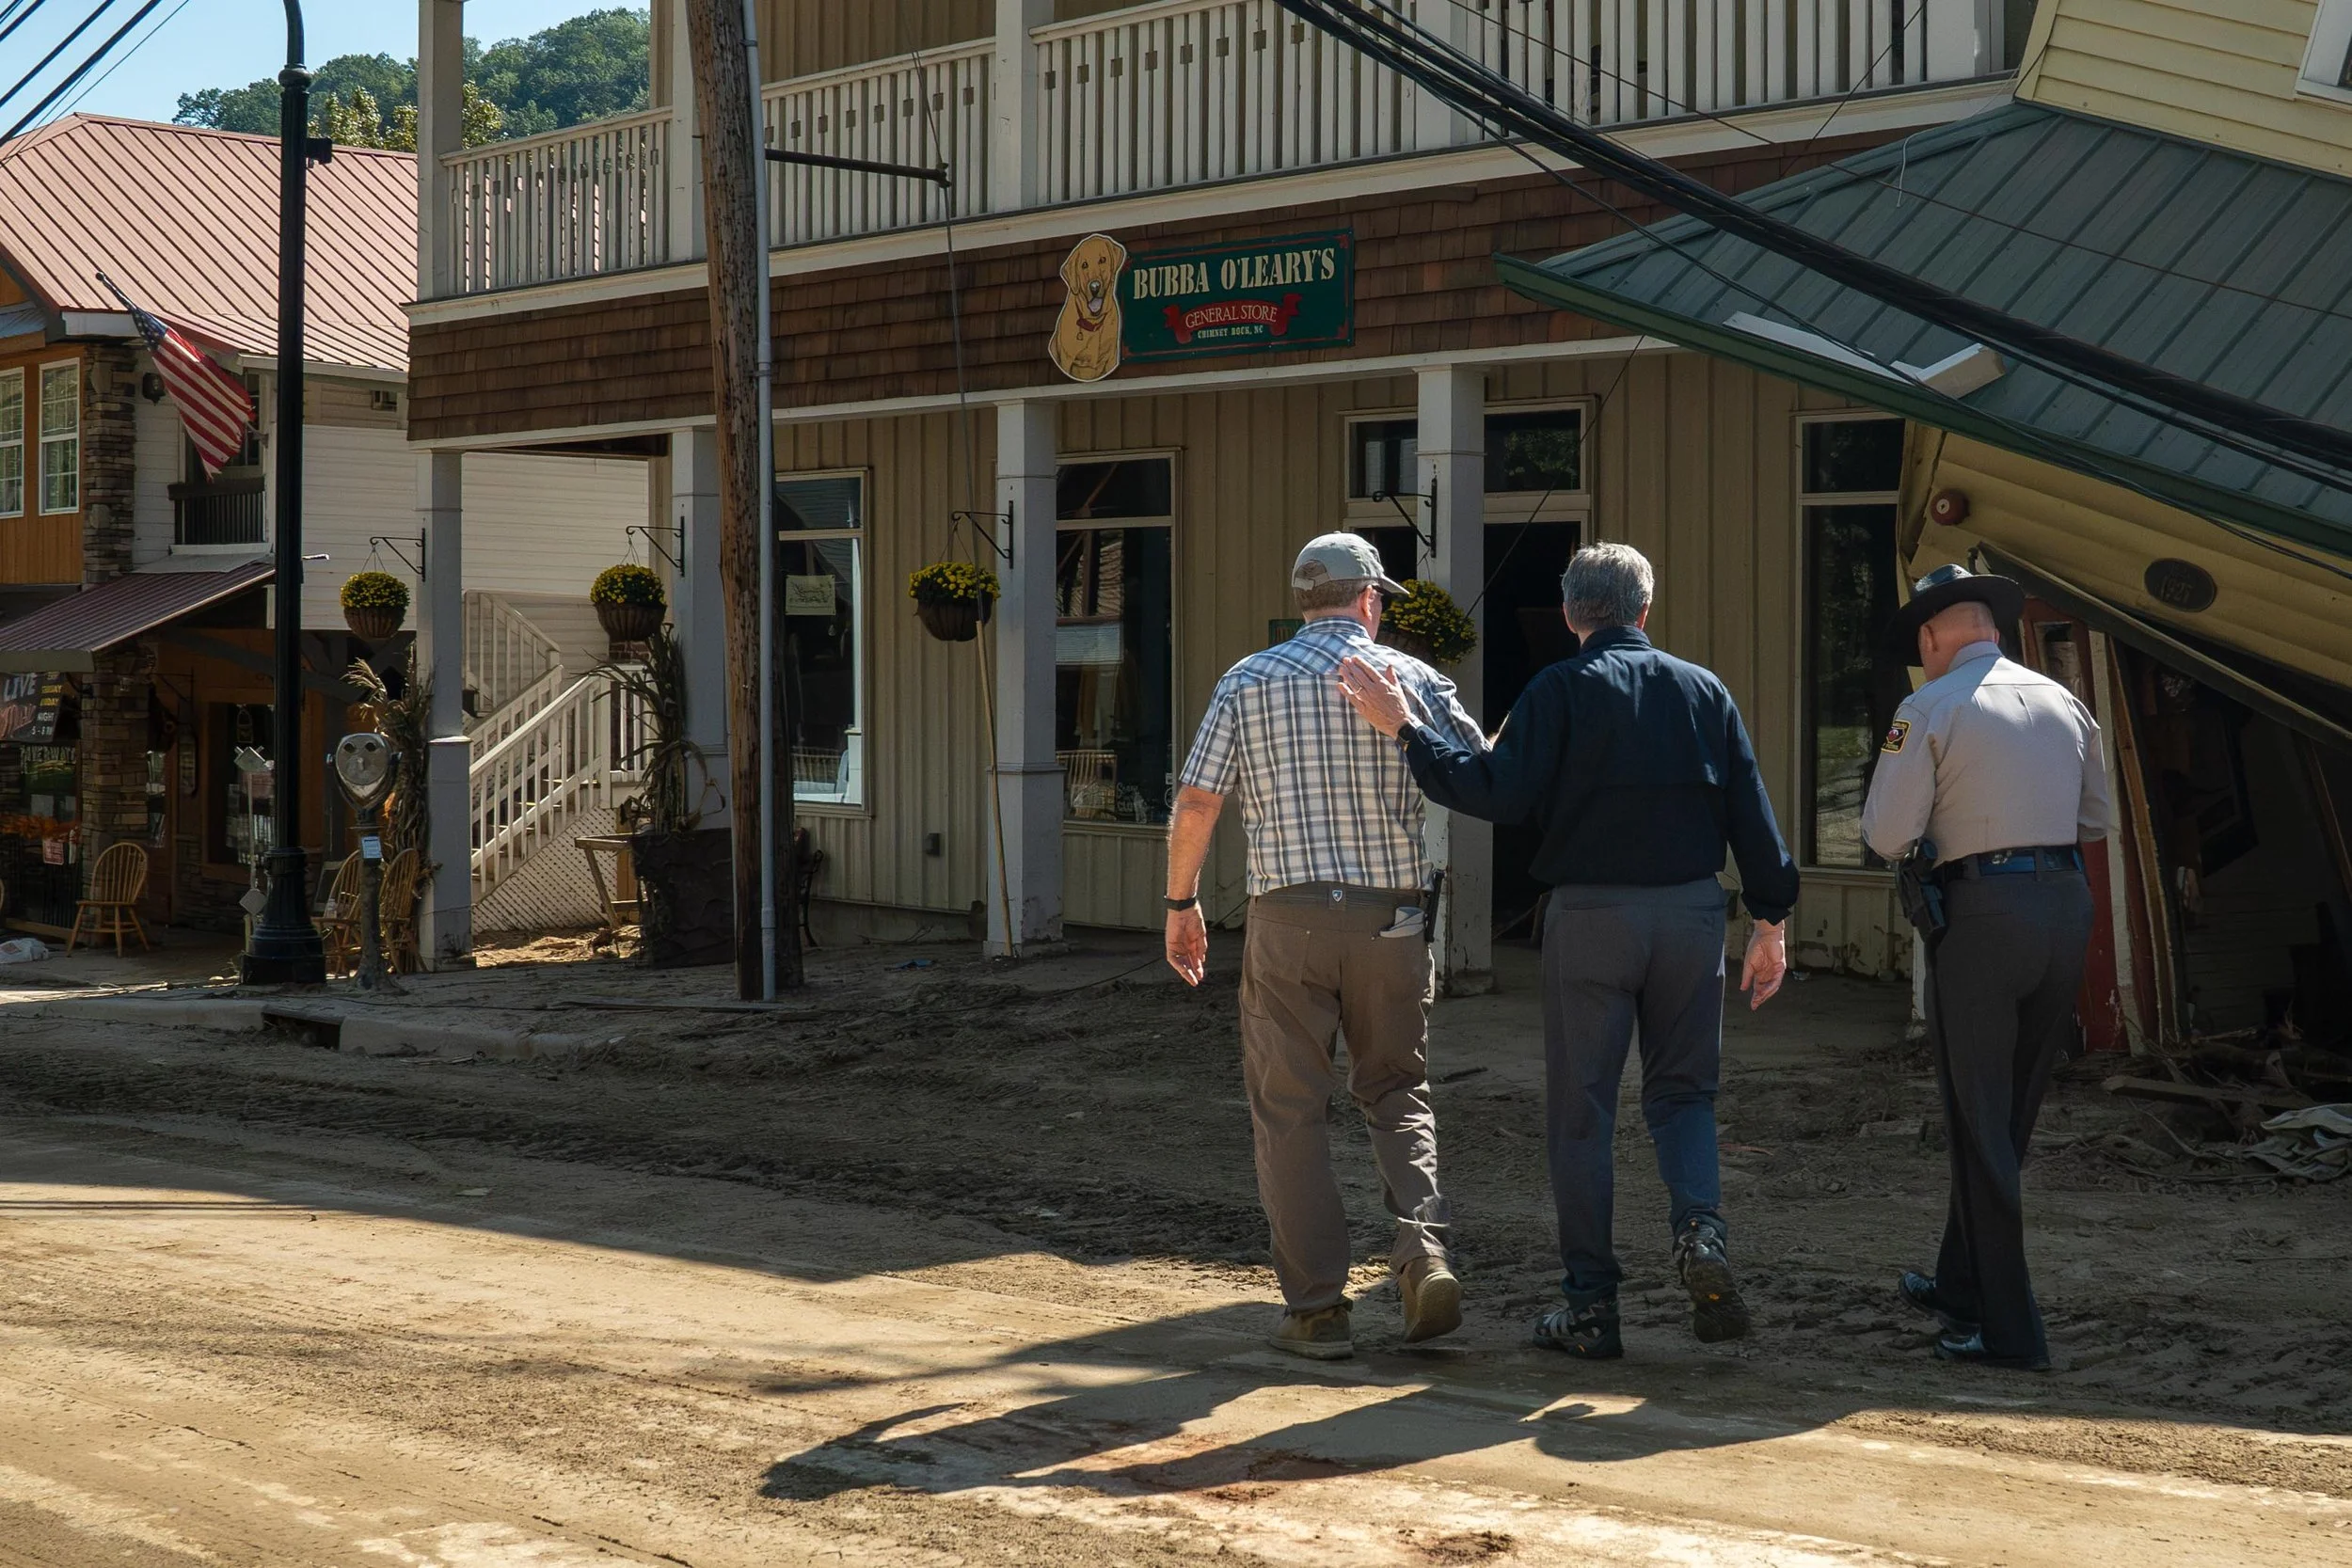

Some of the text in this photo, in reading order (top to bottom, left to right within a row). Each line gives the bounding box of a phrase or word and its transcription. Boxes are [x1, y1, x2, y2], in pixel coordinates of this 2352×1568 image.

[1133, 247, 1336, 300] BUBBA O'LEARY'S
[1184, 305, 1279, 329] GENERAL STORE
[1197, 327, 1229, 339] CHIMNEY
[1253, 325, 1264, 335] NC
[4, 672, 37, 702] LIVE
